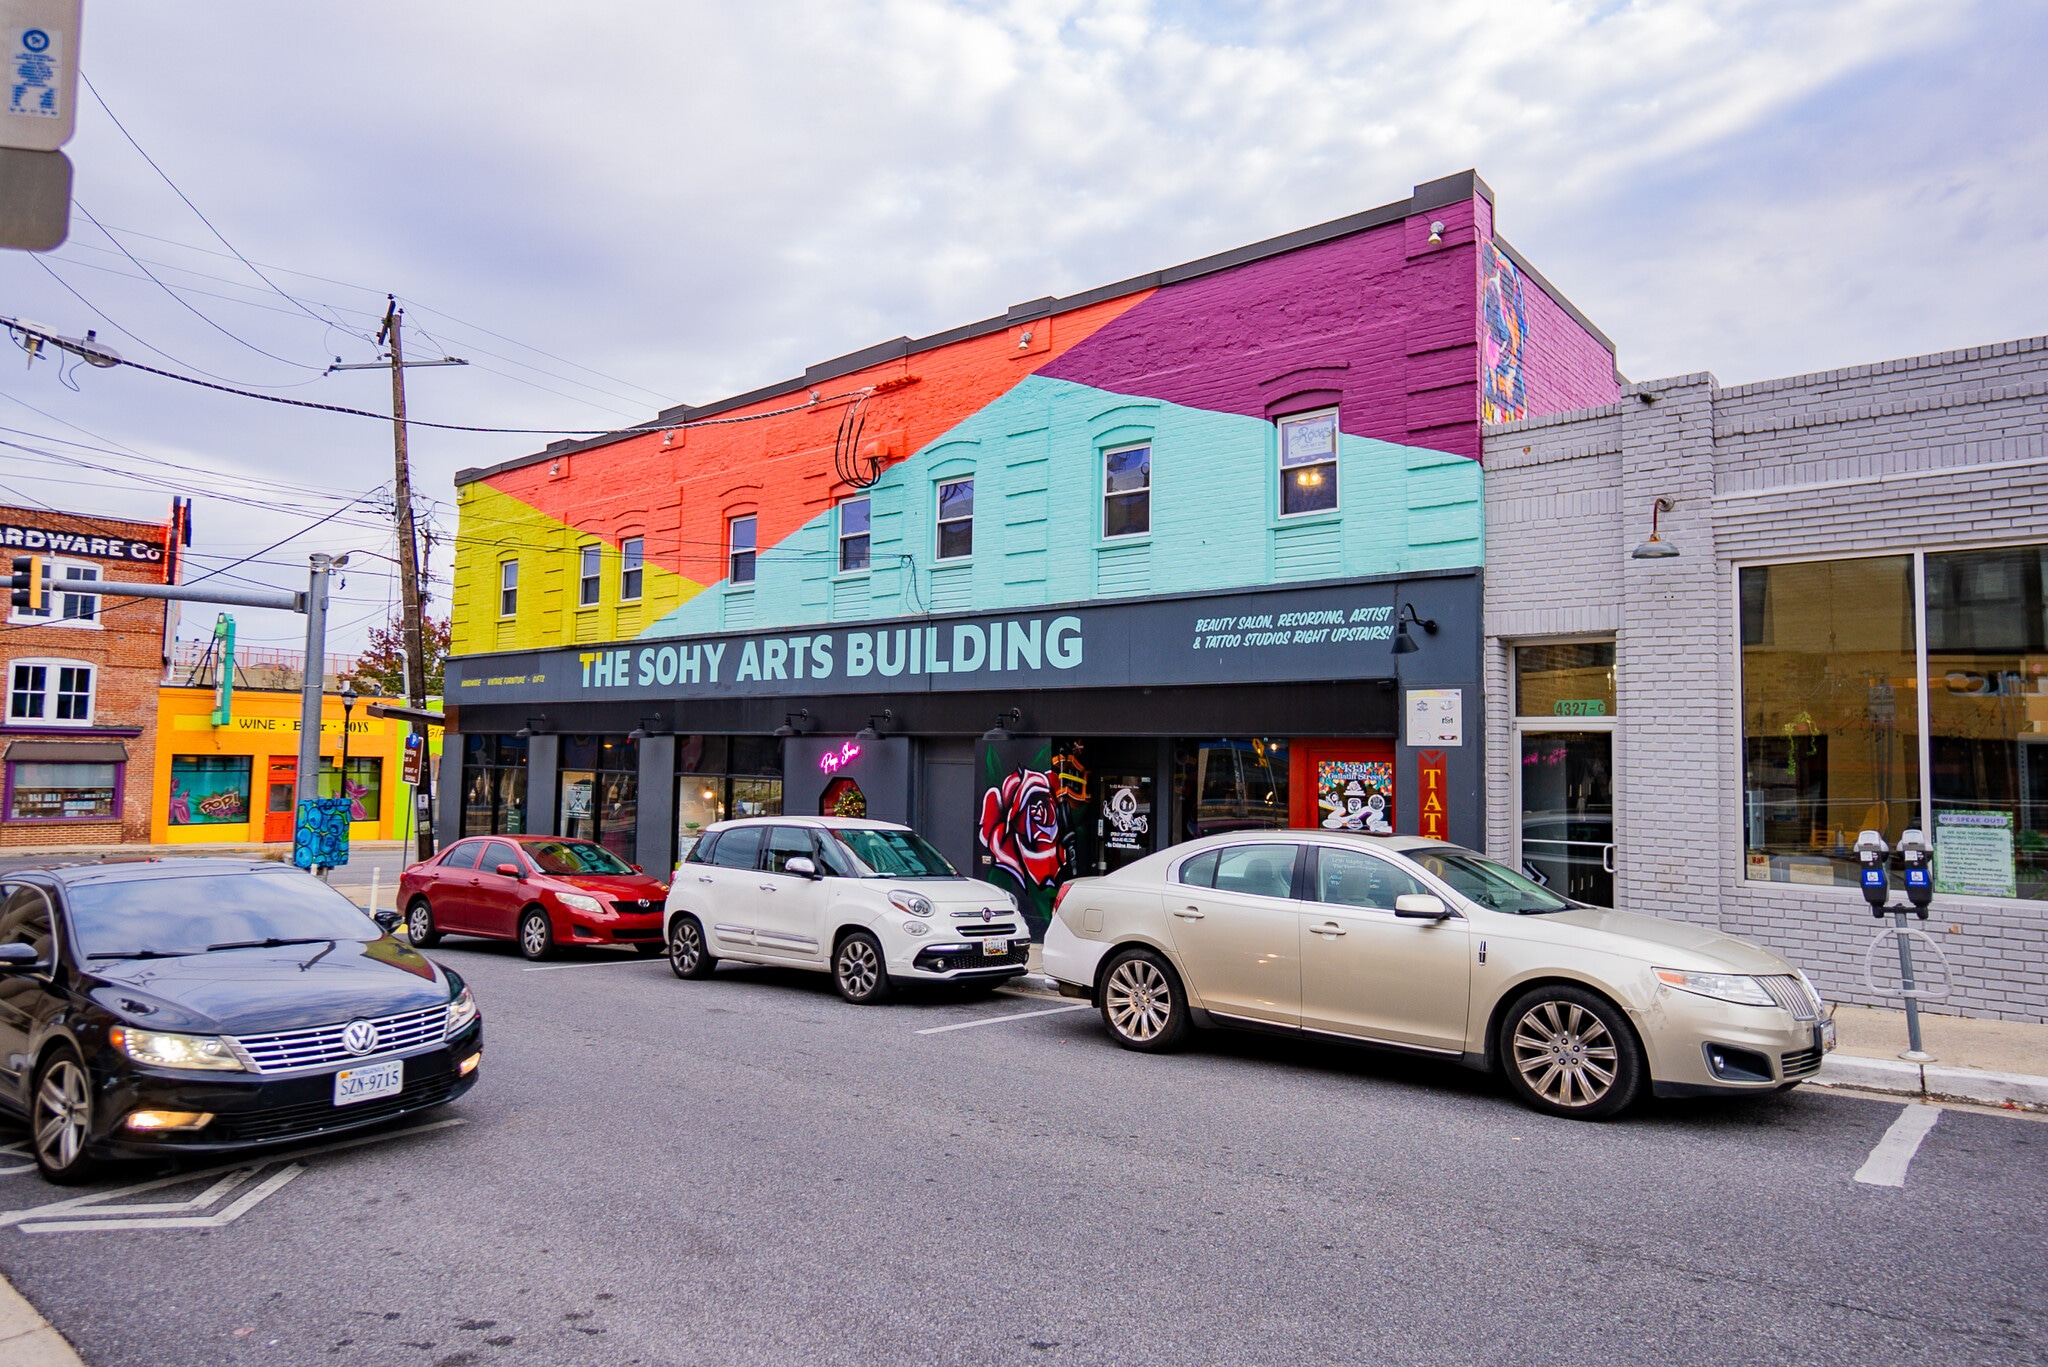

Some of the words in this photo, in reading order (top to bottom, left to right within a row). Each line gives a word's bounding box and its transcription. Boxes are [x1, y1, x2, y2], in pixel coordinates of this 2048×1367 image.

[0, 527, 124, 557] RDWARE
[130, 542, 161, 561] Co
[1195, 616, 1237, 632] BEAUTY
[1237, 614, 1274, 630] SALON,
[1349, 606, 1394, 623] ARTIST
[1193, 636, 1201, 649] &
[1205, 634, 1241, 648] TATTOO
[1243, 630, 1292, 646] STUDIOS
[1292, 628, 1330, 644] RIGHT
[1330, 625, 1394, 642] UPSTAIRS!
[579, 650, 630, 688] THE
[638, 642, 727, 687] SOHY
[736, 634, 834, 682] ARTS
[846, 615, 1083, 677] BUILDING
[1555, 702, 1605, 717] 4327-C
[239, 718, 276, 730] WINE
[200, 791, 240, 814] POP!
[340, 1069, 399, 1096] SZN-9715
